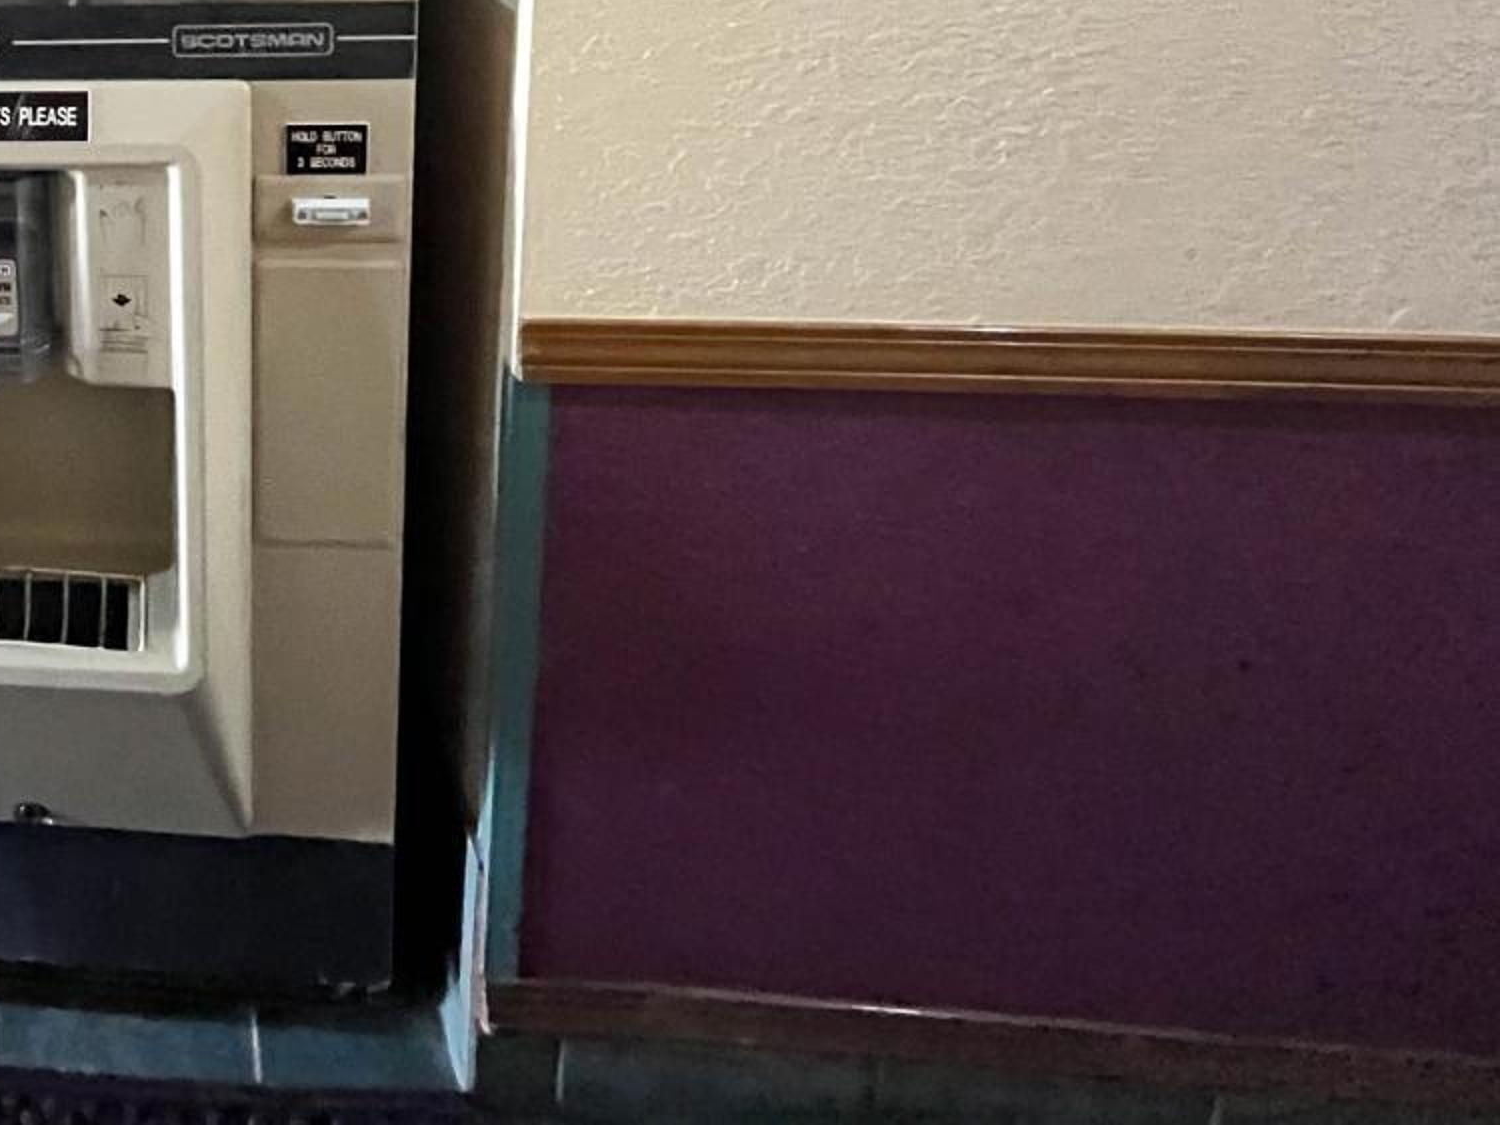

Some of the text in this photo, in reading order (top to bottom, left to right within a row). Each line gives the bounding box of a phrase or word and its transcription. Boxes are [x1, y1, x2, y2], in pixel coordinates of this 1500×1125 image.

[181, 32, 325, 49] SCOTSMAN
[19, 106, 77, 126] PLEASE
[291, 130, 363, 143] HOLD BUTTON
[316, 143, 337, 155] FOR
